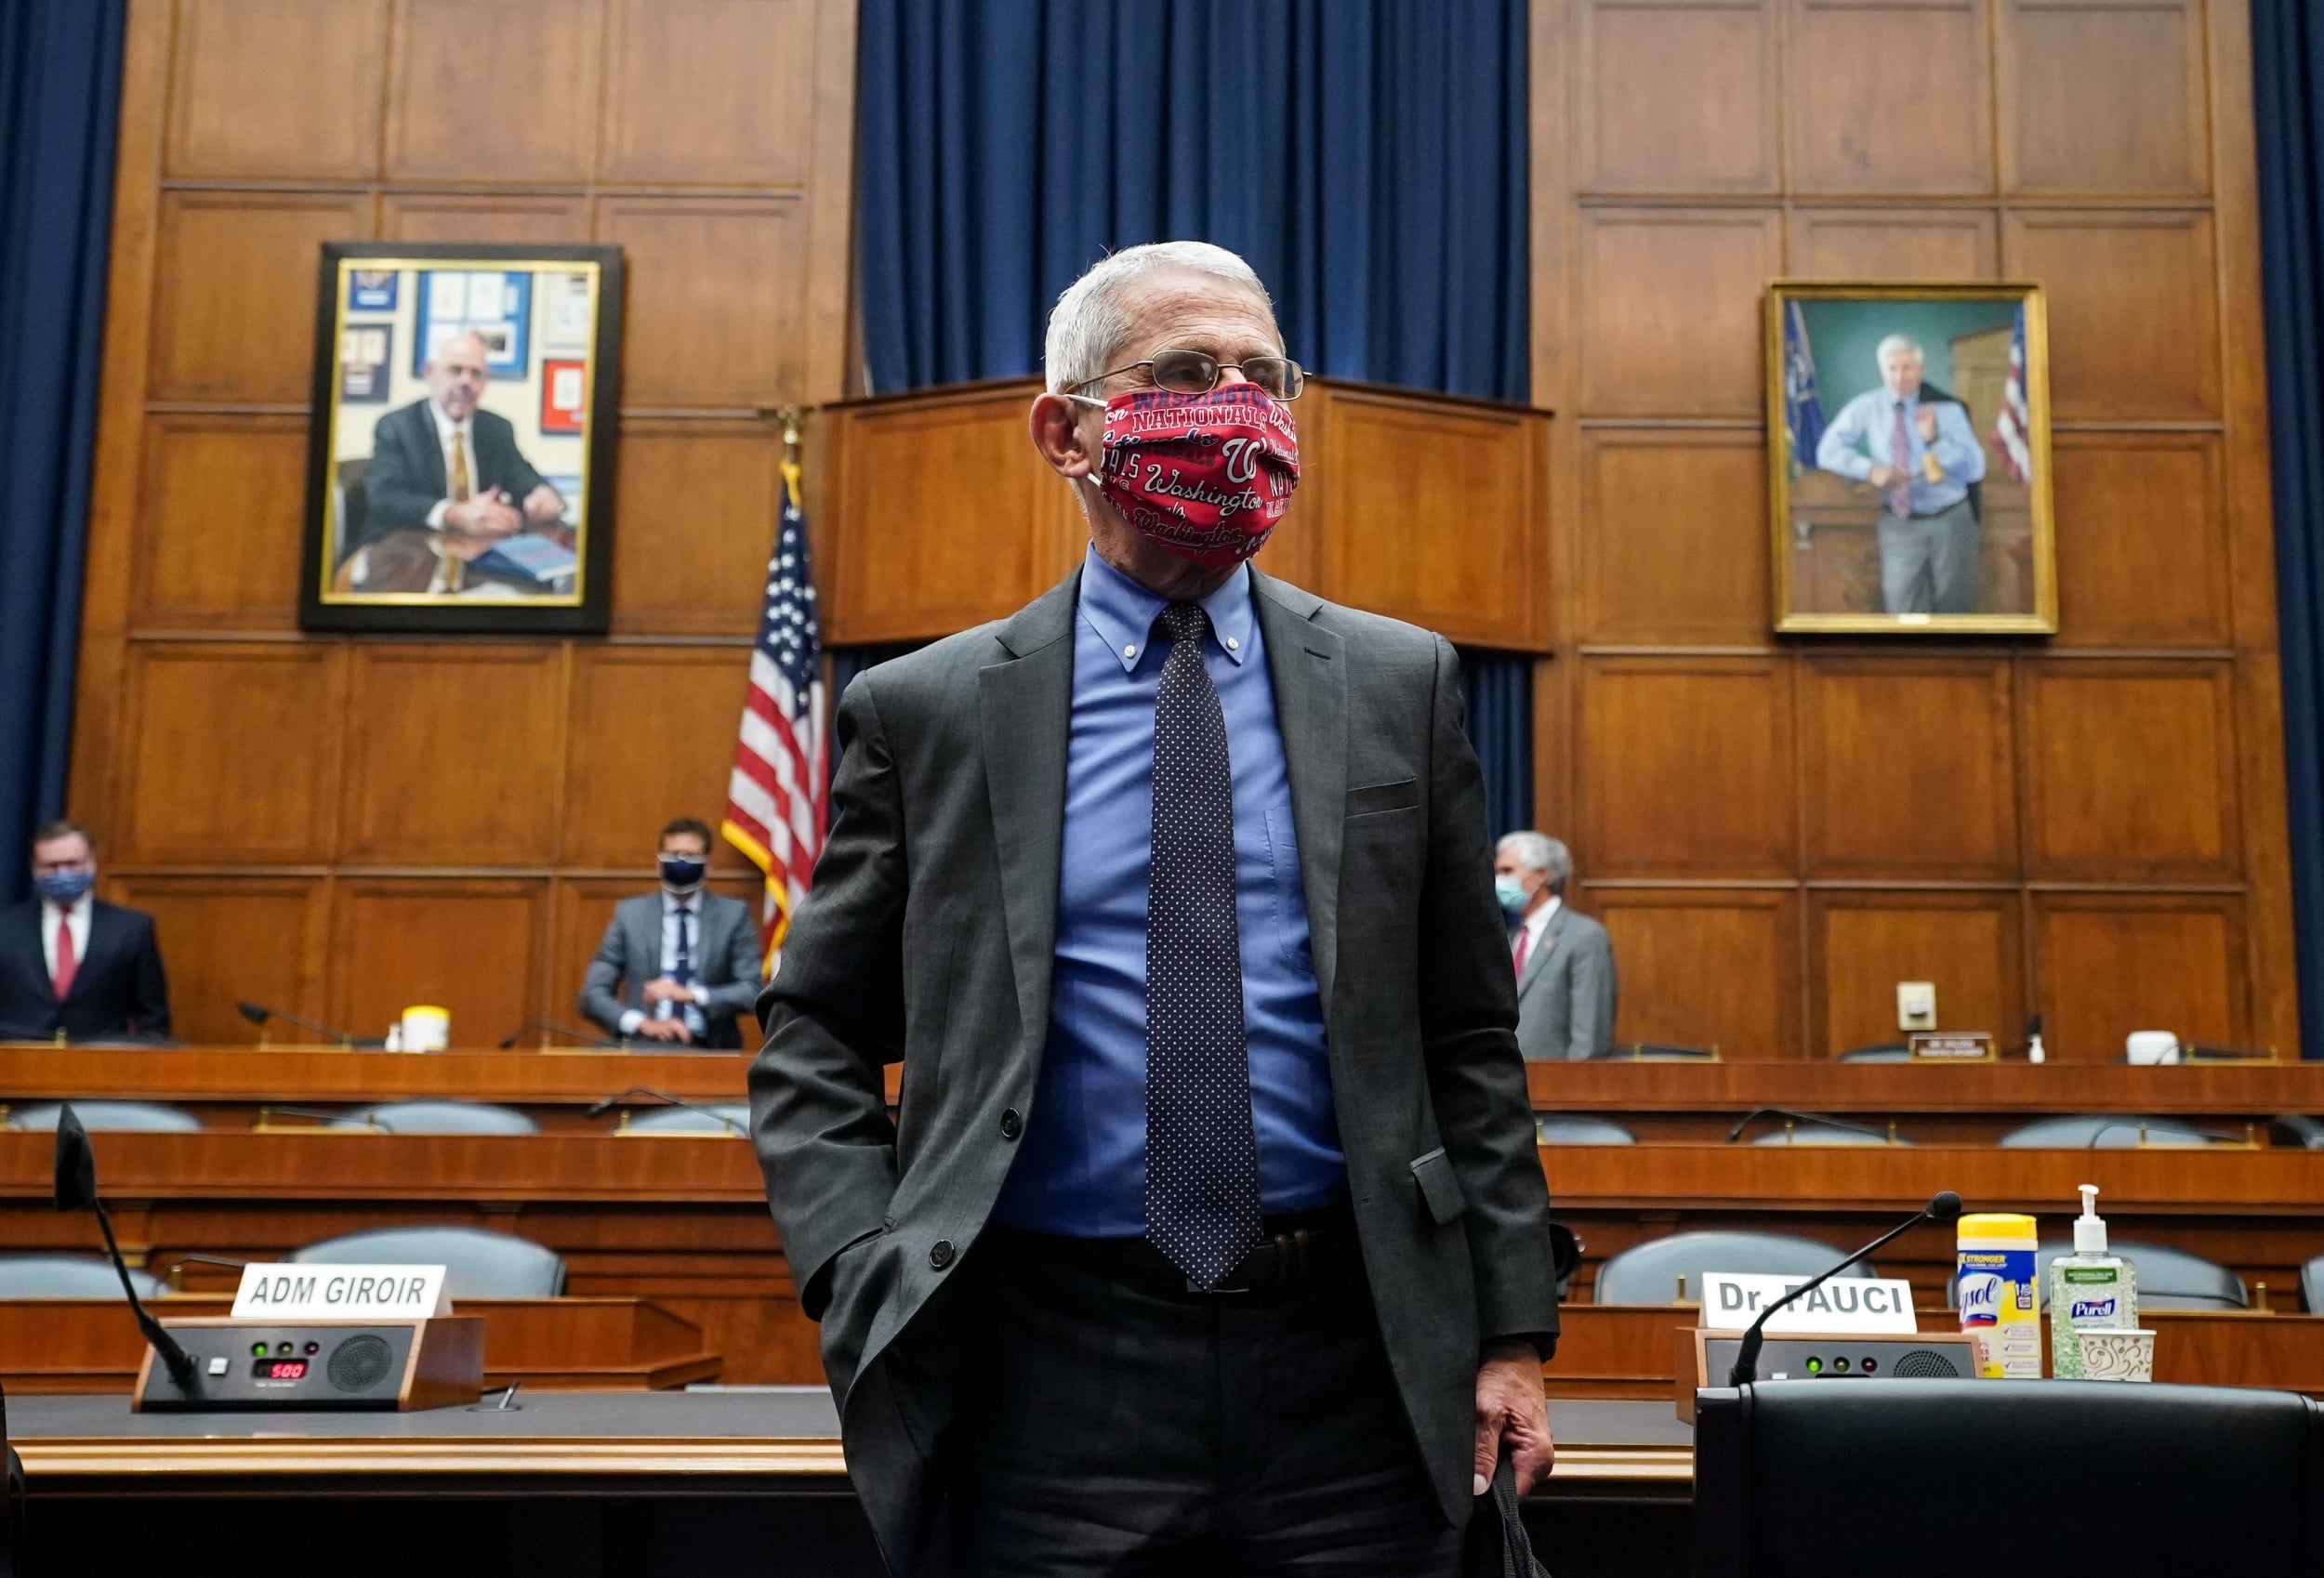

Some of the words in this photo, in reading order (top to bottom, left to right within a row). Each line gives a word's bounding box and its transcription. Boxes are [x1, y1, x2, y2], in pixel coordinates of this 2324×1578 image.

[1132, 406, 1267, 433] NATIONALS
[1221, 437, 1267, 483] W
[1144, 465, 1262, 516] Washington
[1966, 1255, 2006, 1264] STRONGER
[250, 1277, 317, 1303] ADM
[325, 1277, 426, 1303] GIROIR
[1960, 1277, 1997, 1313] ysol
[2075, 1302, 2112, 1316] Purell
[271, 1363, 305, 1378] 500
